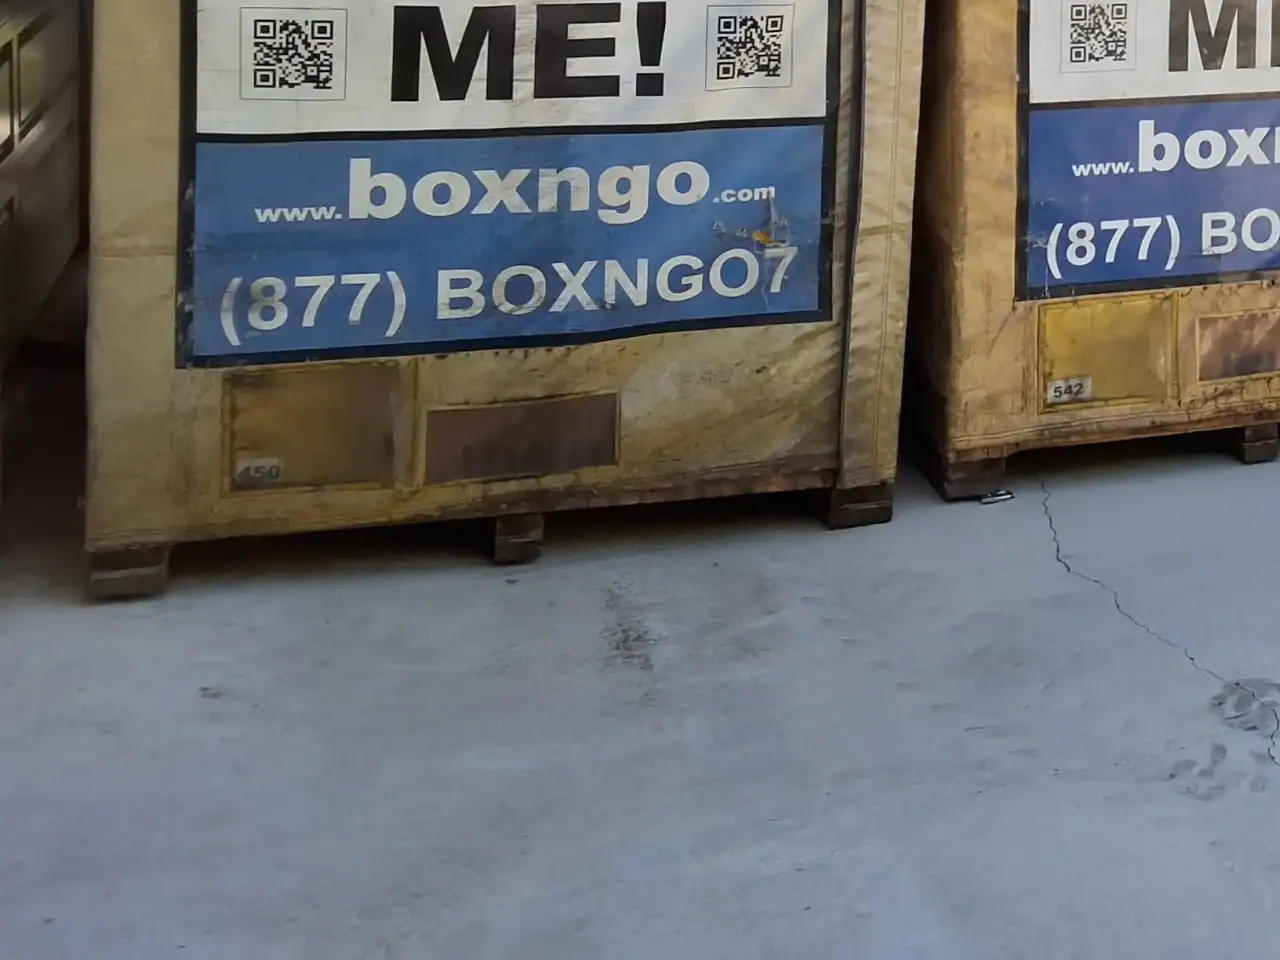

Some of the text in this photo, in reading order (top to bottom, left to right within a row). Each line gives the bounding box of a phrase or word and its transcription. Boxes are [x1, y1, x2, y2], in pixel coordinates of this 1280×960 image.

[390, 1, 667, 102] ME!
[1046, 214, 1181, 279] (877)
[220, 247, 798, 345] (877) BOXNGO7
[1053, 383, 1084, 398] 542
